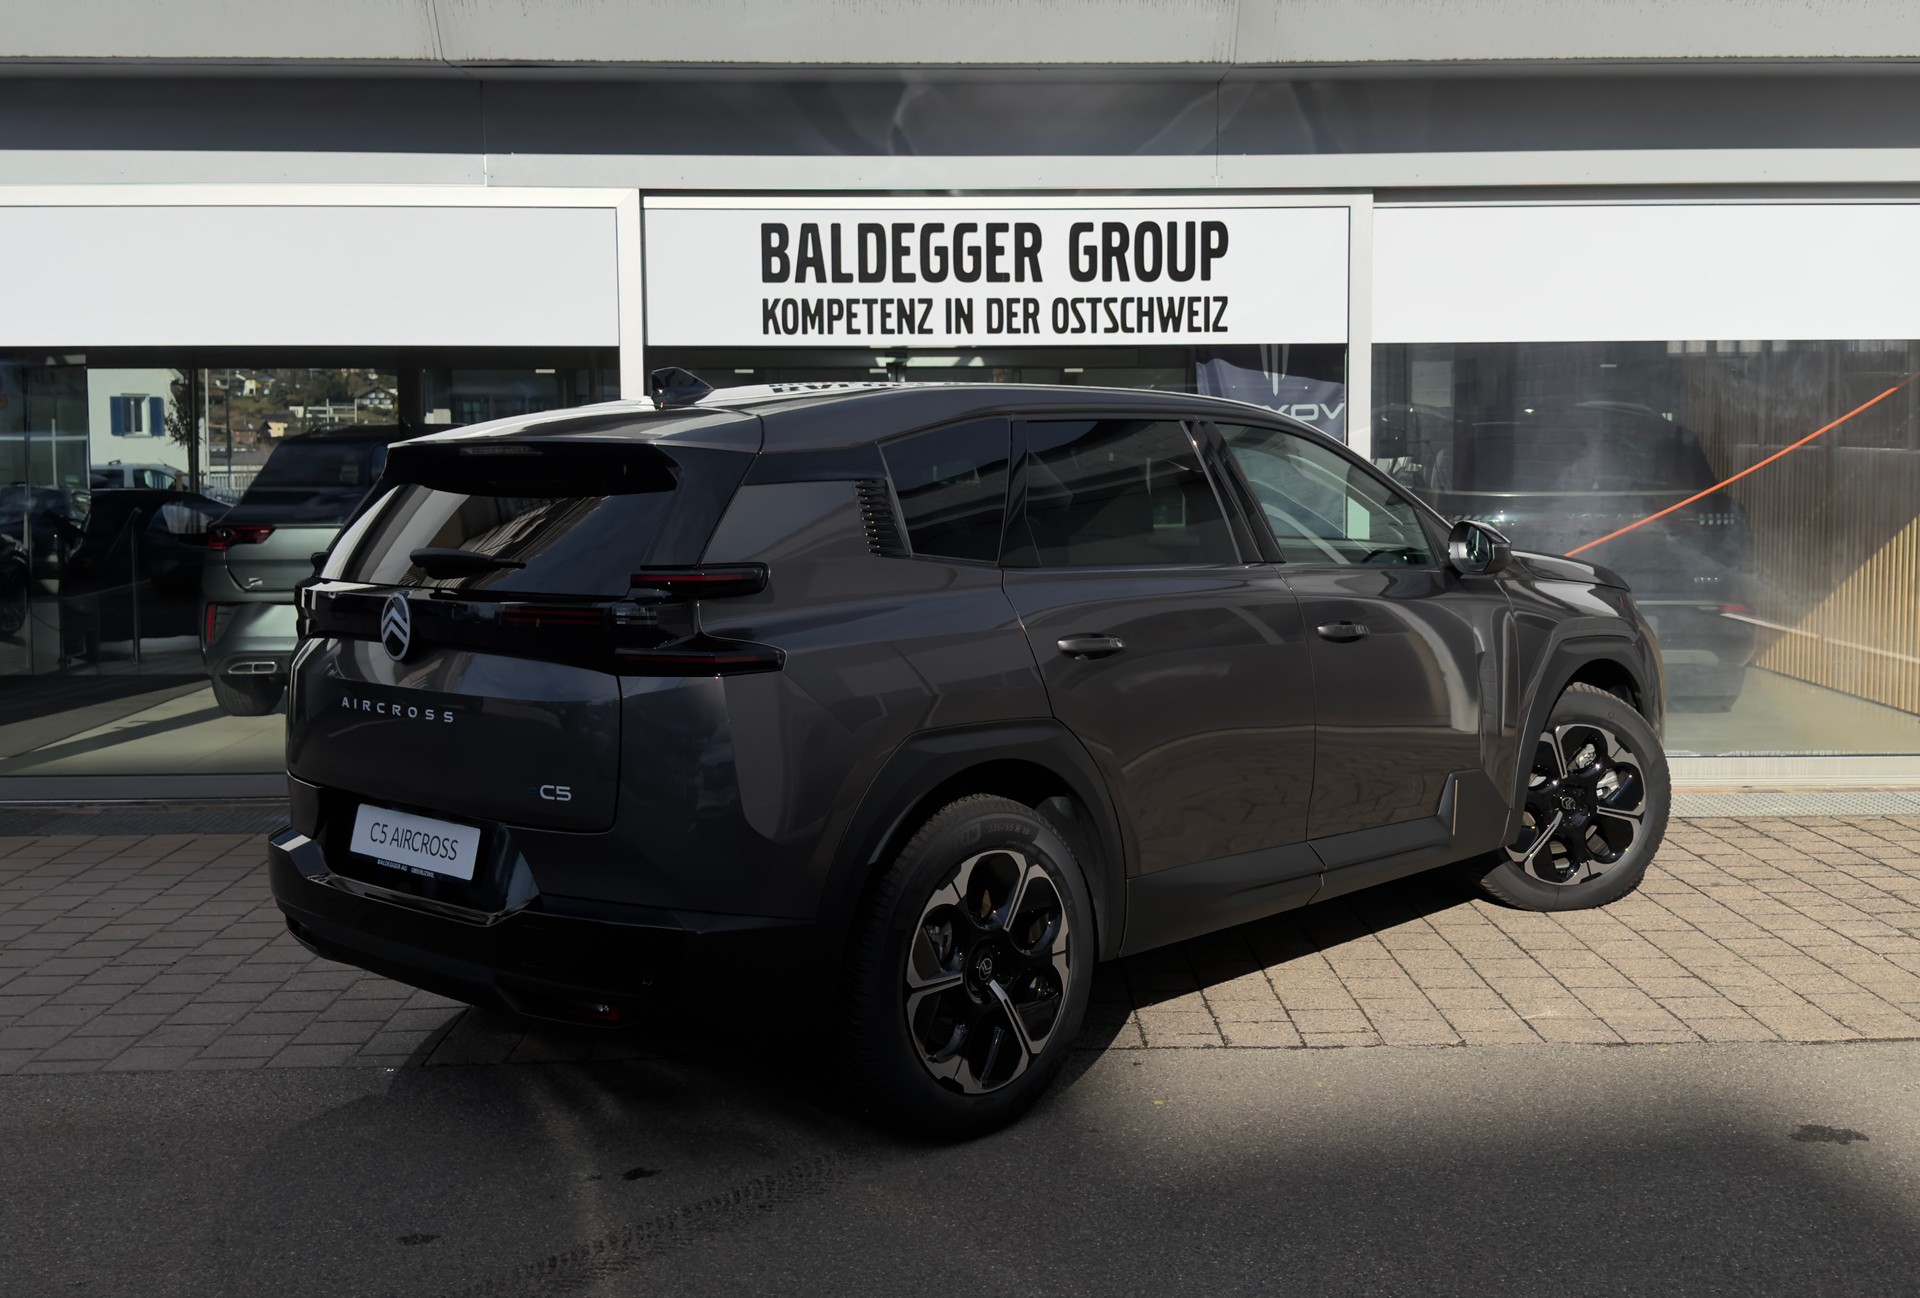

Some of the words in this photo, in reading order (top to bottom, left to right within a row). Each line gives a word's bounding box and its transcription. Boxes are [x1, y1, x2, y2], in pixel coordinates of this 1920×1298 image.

[761, 223, 1043, 283] BALDEGGER
[1069, 221, 1229, 282] GROUP
[762, 297, 934, 335] KOMPETENZ
[946, 297, 974, 334] IN
[987, 297, 1040, 334] DER
[1052, 296, 1229, 335] OSTSCHWEIZ
[342, 697, 454, 723] AIRCROSS
[370, 822, 389, 844] C5
[389, 826, 459, 861] AIRCROSS
